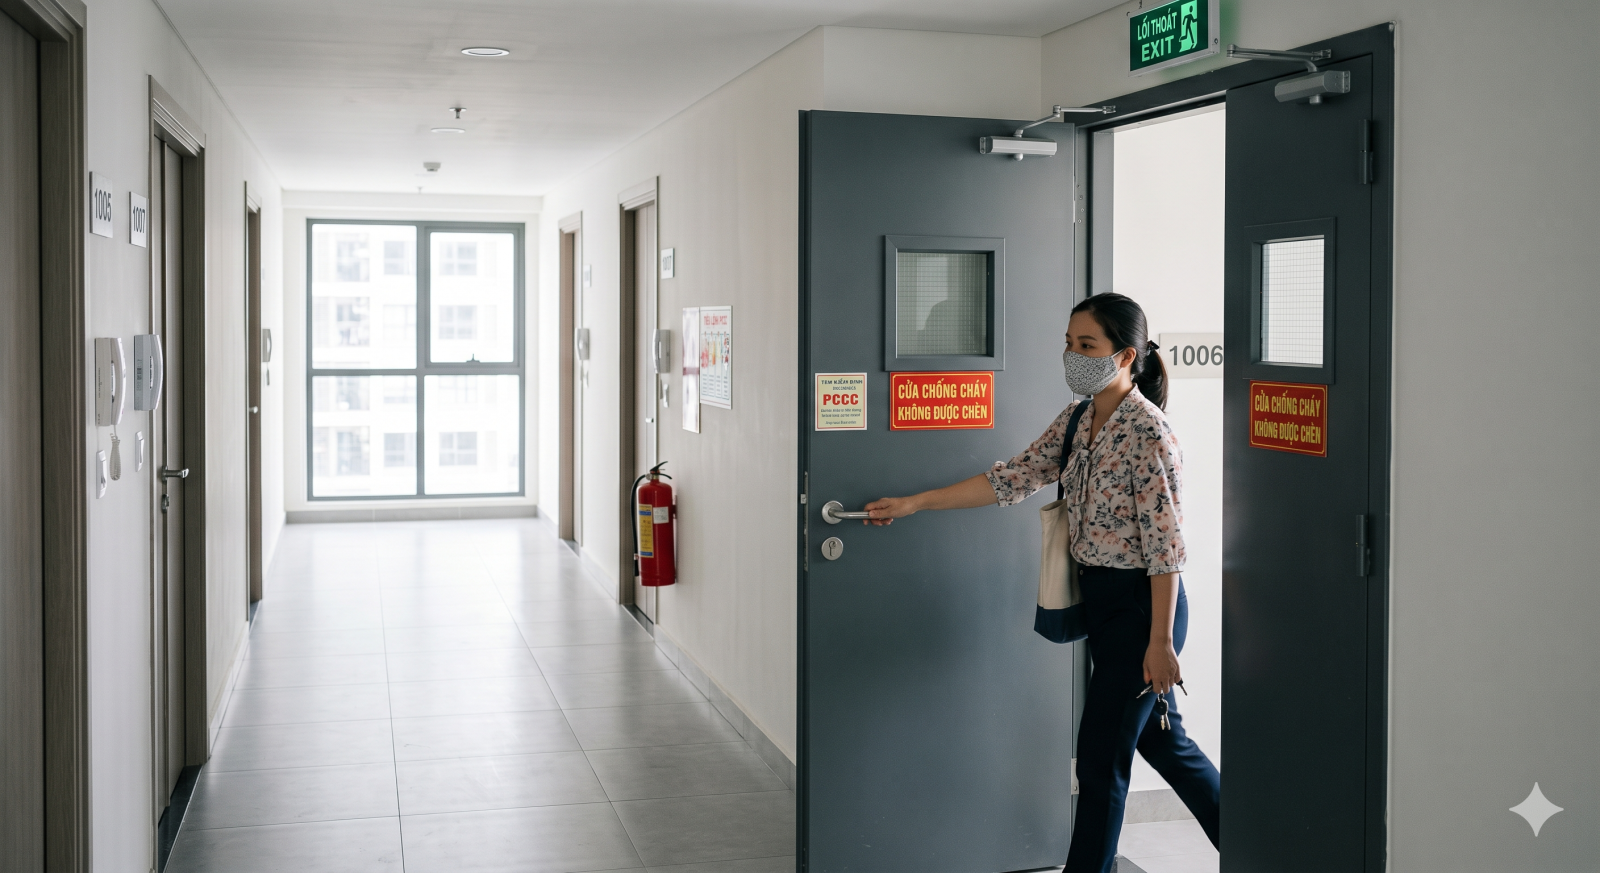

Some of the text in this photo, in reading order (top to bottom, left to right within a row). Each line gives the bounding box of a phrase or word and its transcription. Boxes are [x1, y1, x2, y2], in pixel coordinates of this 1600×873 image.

[1137, 8, 1178, 41] LỐI THOÁT
[1141, 35, 1175, 62] EXIT
[95, 188, 112, 222] 1005
[133, 206, 145, 233] 1007
[1169, 345, 1223, 366] 1006
[822, 393, 859, 406] PCCC
[898, 378, 987, 399] CỬA CHỐNG CHÁY
[898, 401, 988, 424] KHÔNG ĐƯỢC CHÈN
[1255, 389, 1321, 418] CỬA CHỐNG CHÁY
[1254, 418, 1321, 446] KHÔNG ĐƯỢC CHÈN
